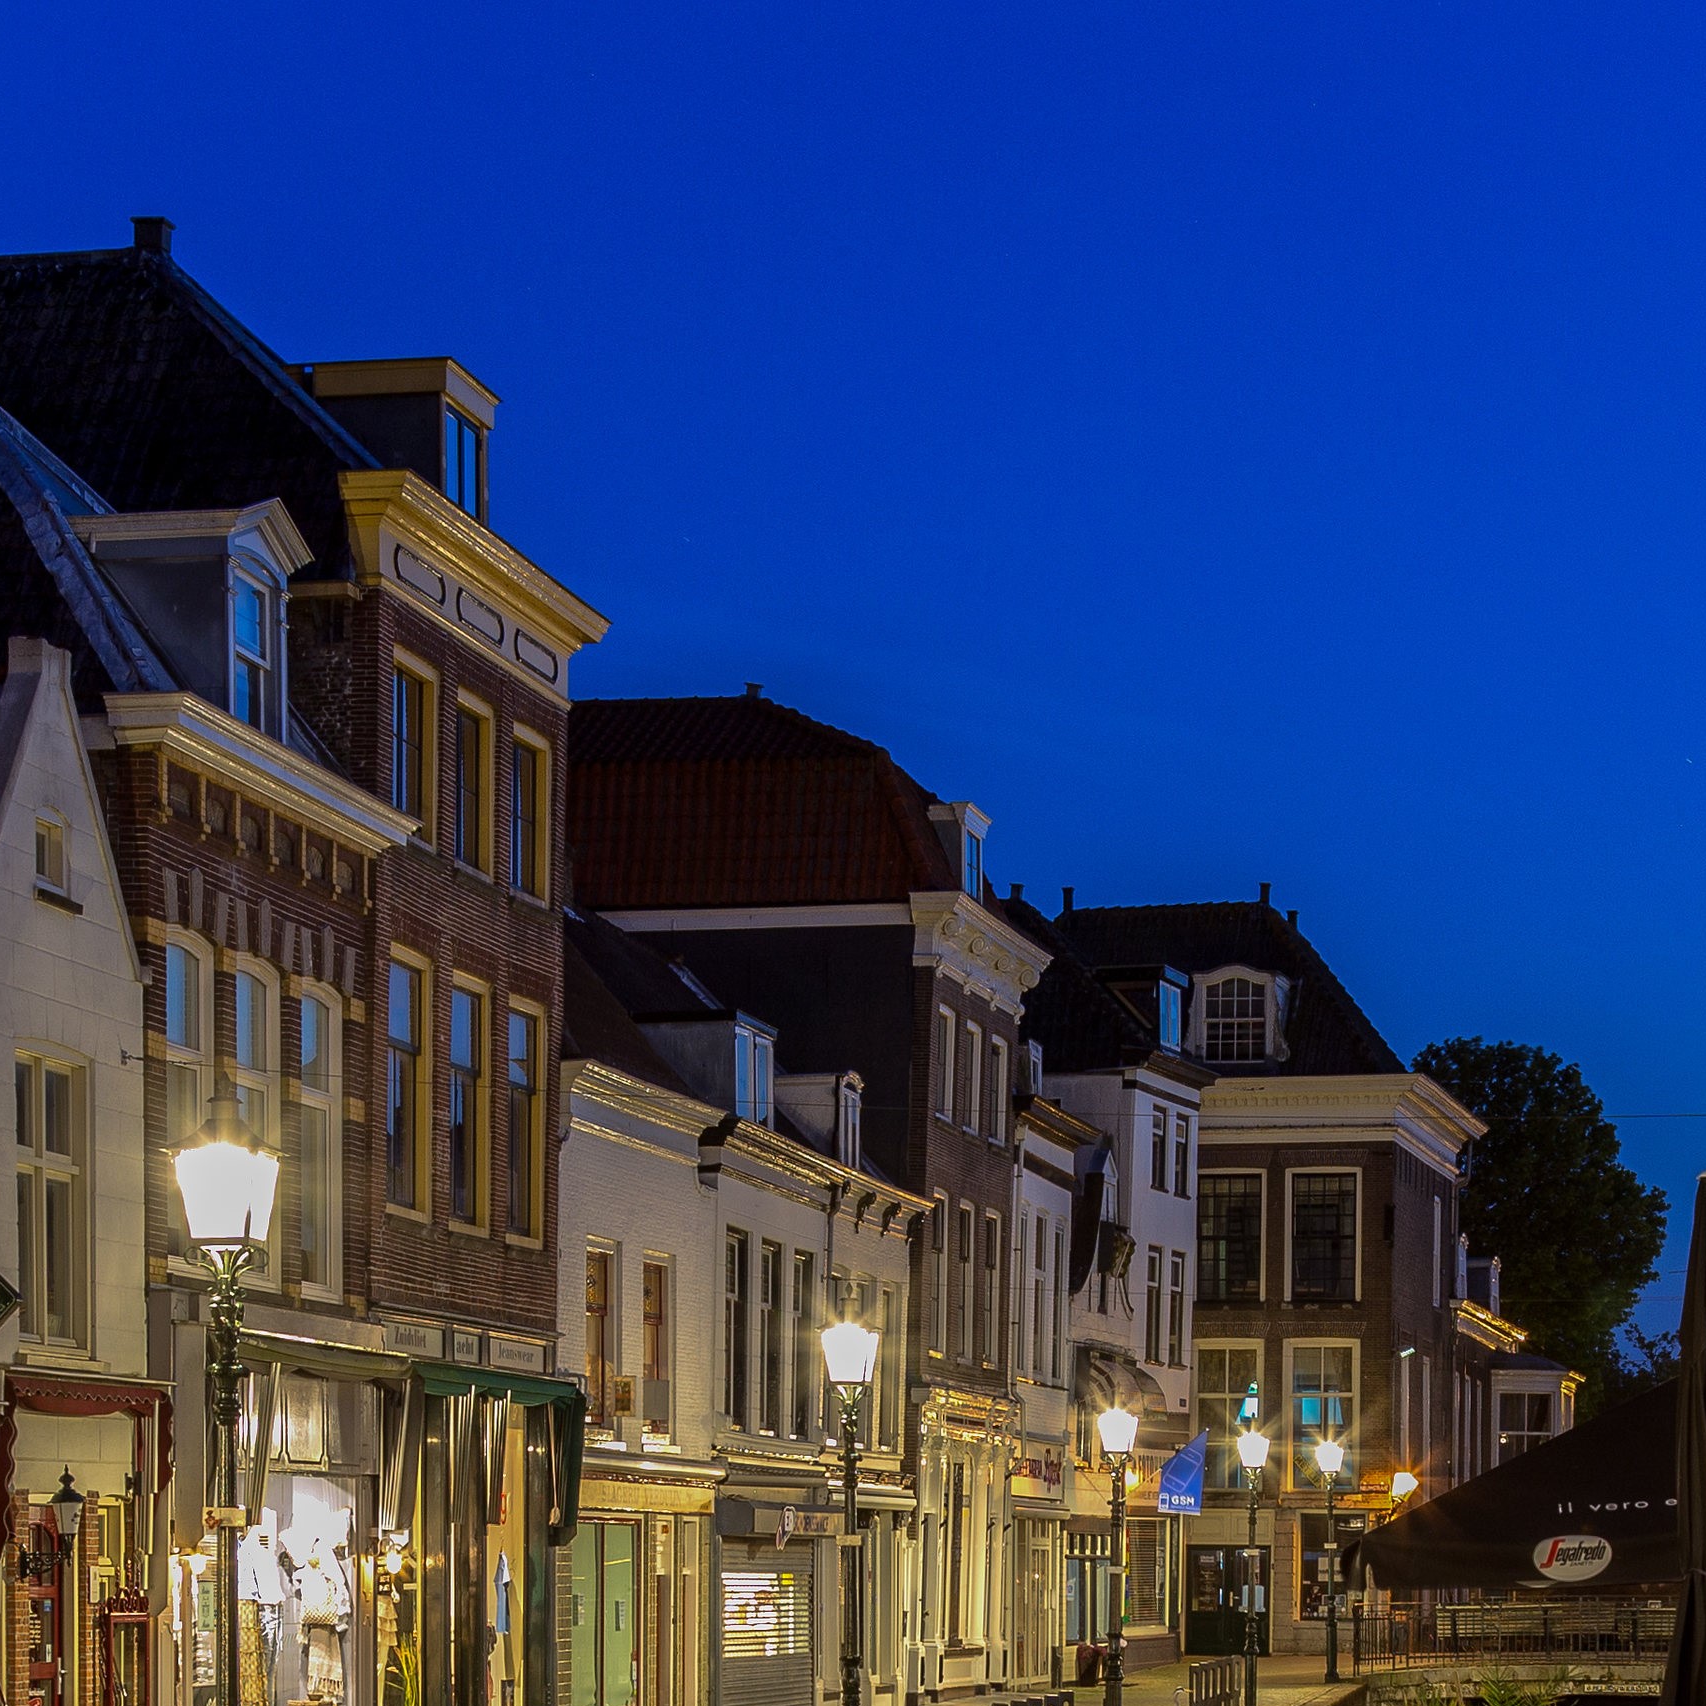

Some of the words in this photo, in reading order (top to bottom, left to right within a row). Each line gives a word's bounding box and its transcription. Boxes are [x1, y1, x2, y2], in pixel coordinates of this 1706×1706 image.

[394, 1325, 427, 1348] Zuidvliet
[456, 1337, 474, 1355] acht
[498, 1342, 534, 1363] Jeanswear
[1171, 1494, 1195, 1506] GSM
[1558, 1502, 1573, 1514] il
[1589, 1501, 1649, 1512] vero
[1539, 1539, 1607, 1569] Segafredo
